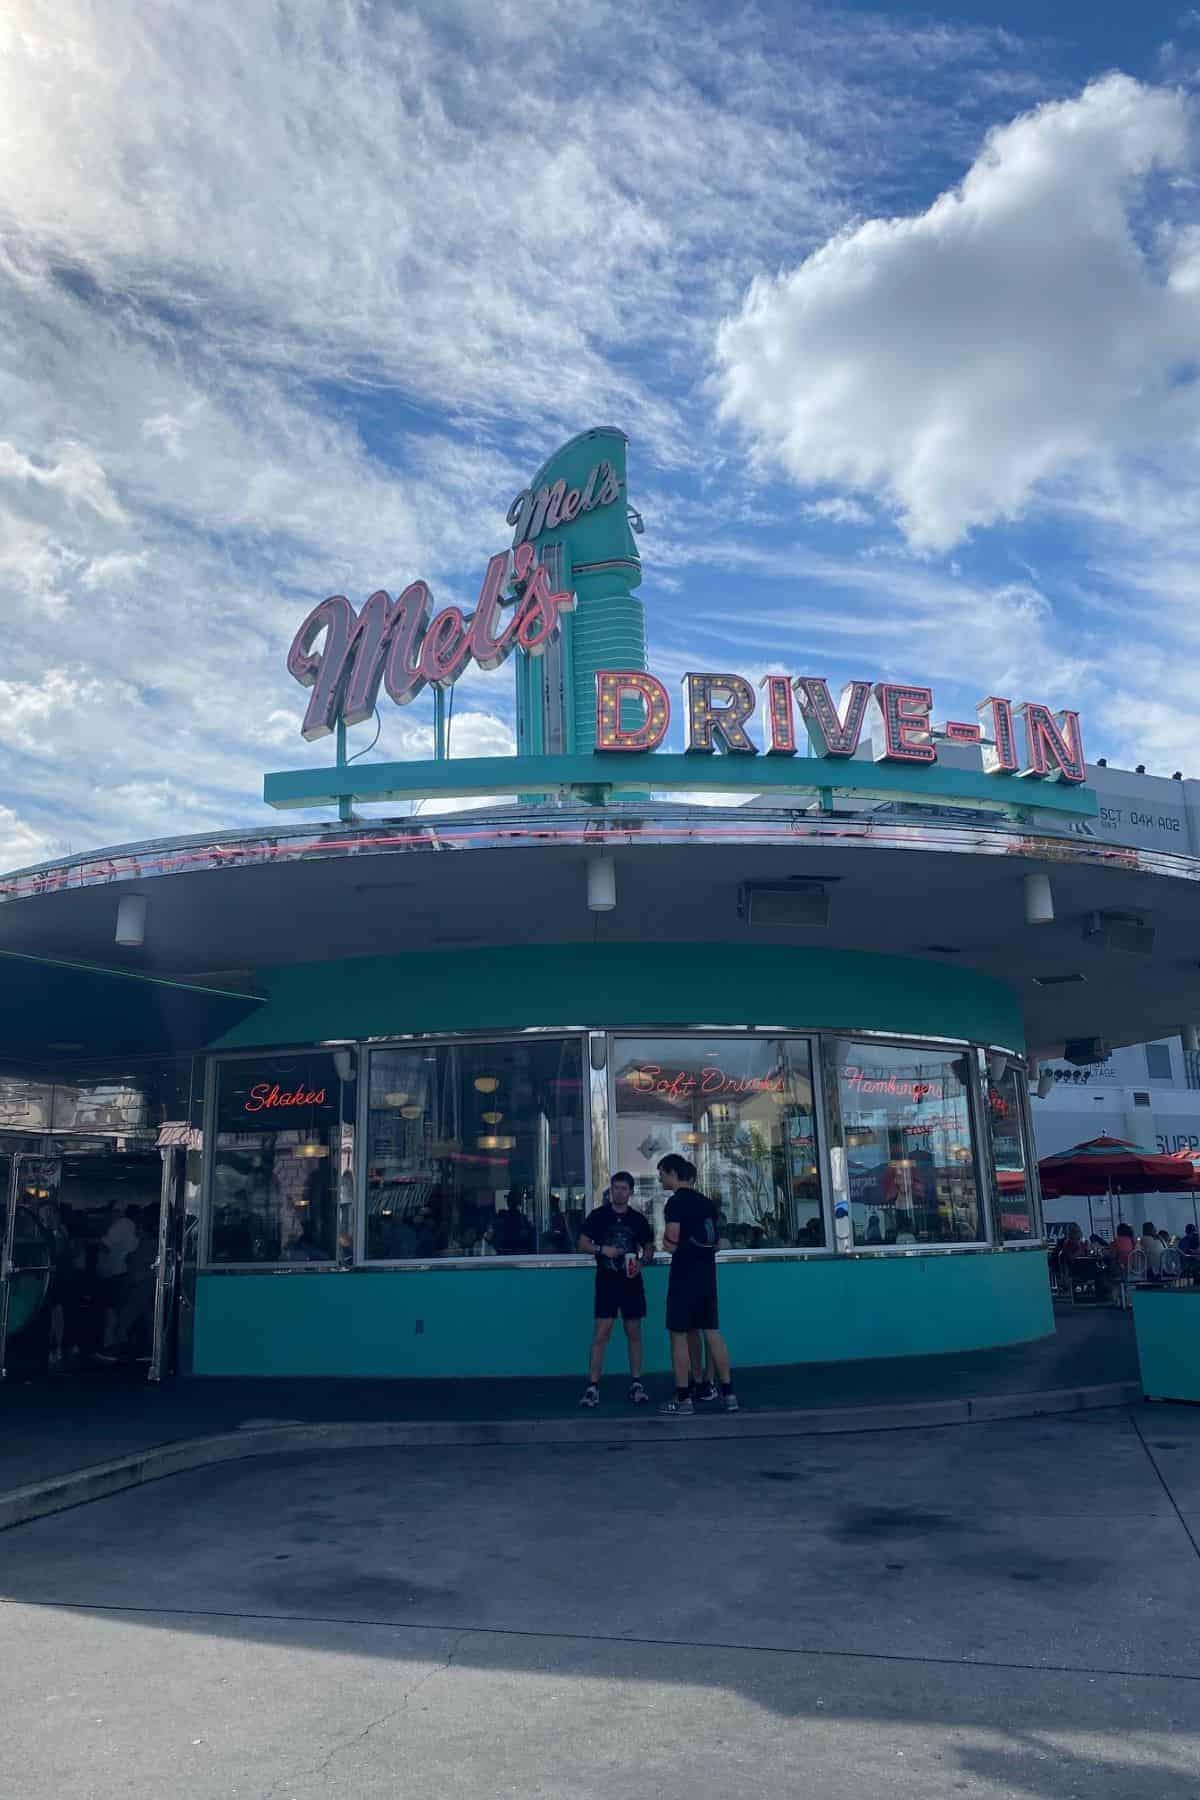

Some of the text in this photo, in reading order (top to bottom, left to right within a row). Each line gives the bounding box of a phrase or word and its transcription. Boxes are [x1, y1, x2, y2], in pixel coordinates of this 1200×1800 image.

[506, 461, 624, 547] Mel's
[286, 541, 578, 743] Mel's
[593, 670, 1087, 785] DRIVE-IN
[244, 1083, 327, 1112] Shakes
[632, 1064, 786, 1105] Soft Drinks
[843, 1066, 944, 1103] Hamburgers
